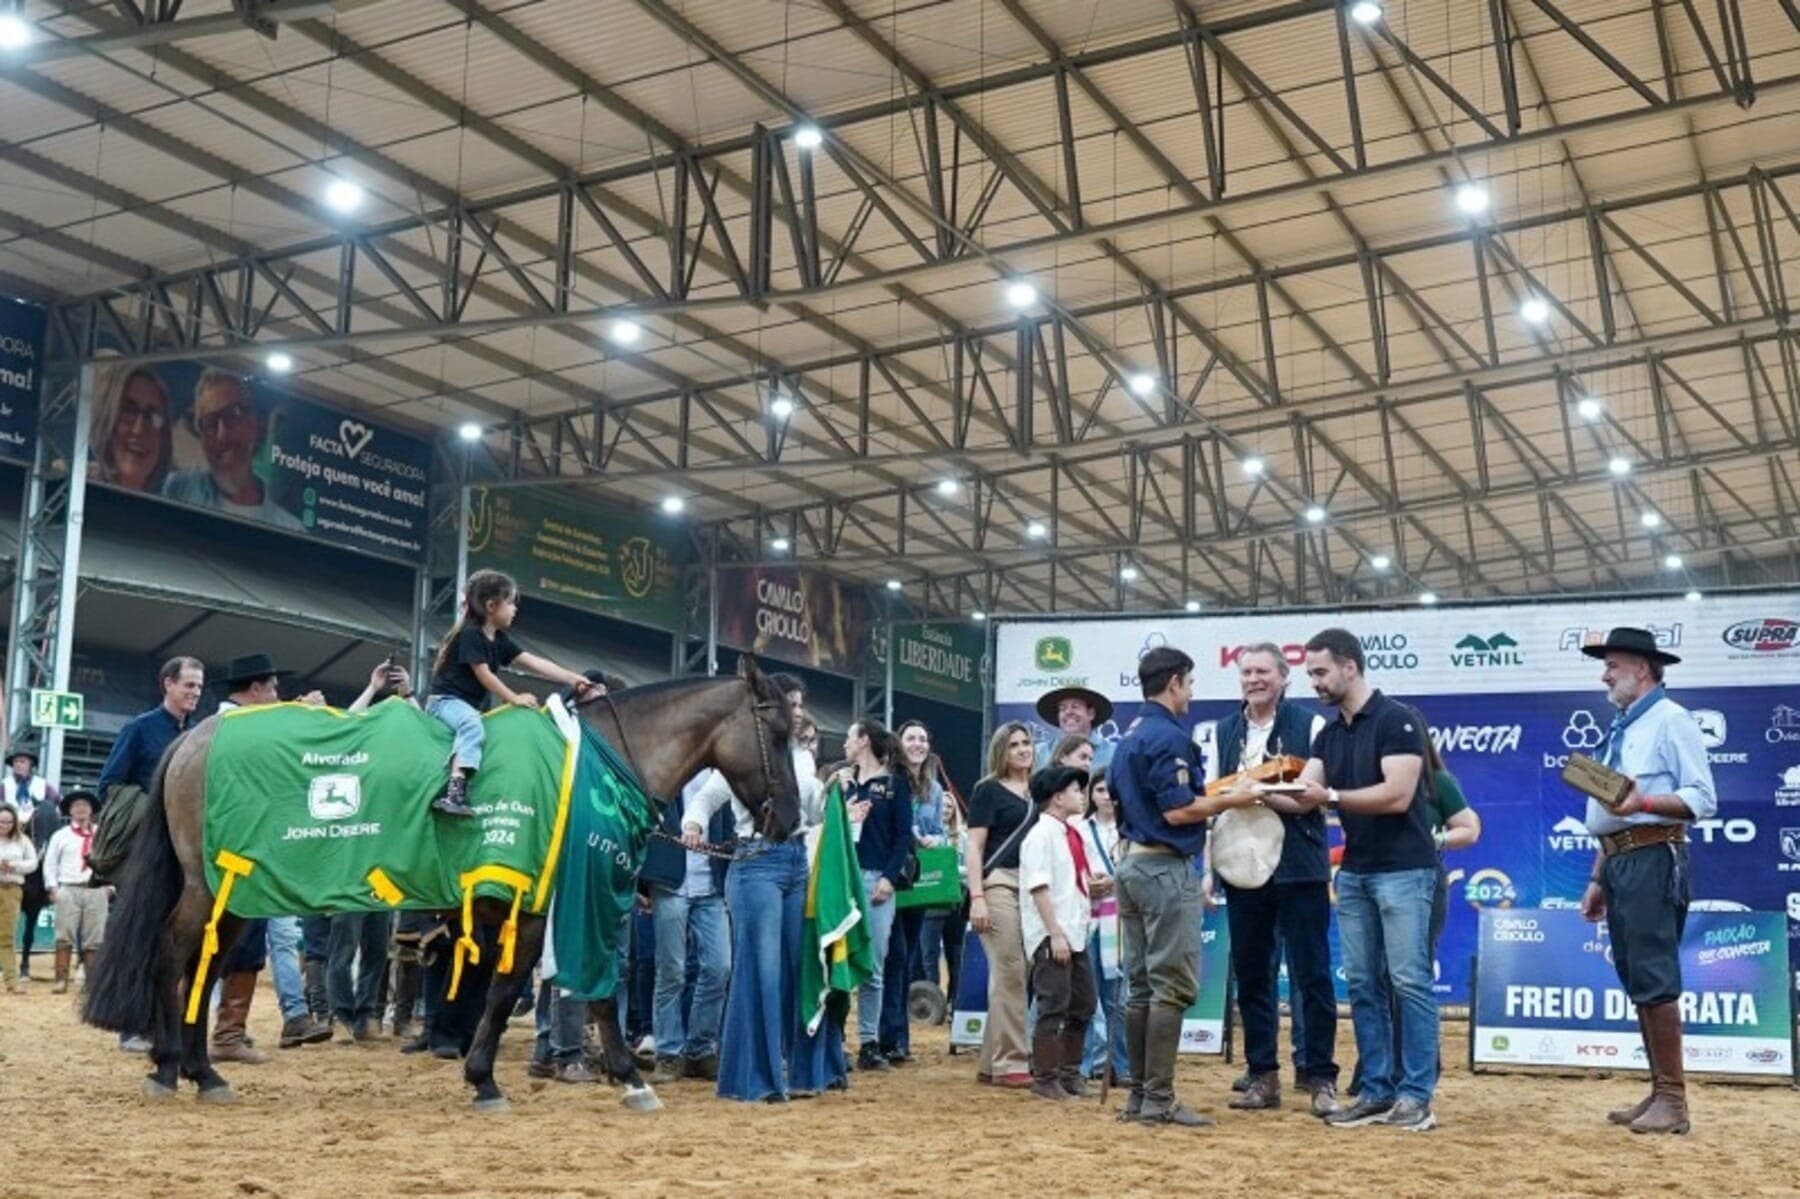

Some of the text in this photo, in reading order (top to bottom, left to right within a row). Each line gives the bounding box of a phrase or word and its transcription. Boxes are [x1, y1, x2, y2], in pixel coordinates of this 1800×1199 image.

[309, 433, 345, 457] FACTA
[271, 444, 425, 508] Proteja quem você ama!
[359, 451, 425, 481] SEGURADORA
[757, 579, 804, 614] CAVALO
[755, 608, 811, 644] CRIOULO
[1730, 626, 1798, 643] SUPRA
[899, 637, 973, 682] LIBERDADE
[1451, 651, 1523, 667] VETNIL
[1427, 724, 1522, 754] ONECTA
[302, 752, 369, 766] Alvorada
[282, 822, 381, 840] JOHN DEERE
[1548, 835, 1600, 850] VETN
[1690, 819, 1757, 843] TO
[1464, 885, 1517, 900] 2024
[1506, 985, 1594, 1019] FREIO
[1680, 992, 1759, 1025] RATA
[1576, 1044, 1619, 1057] KTO
